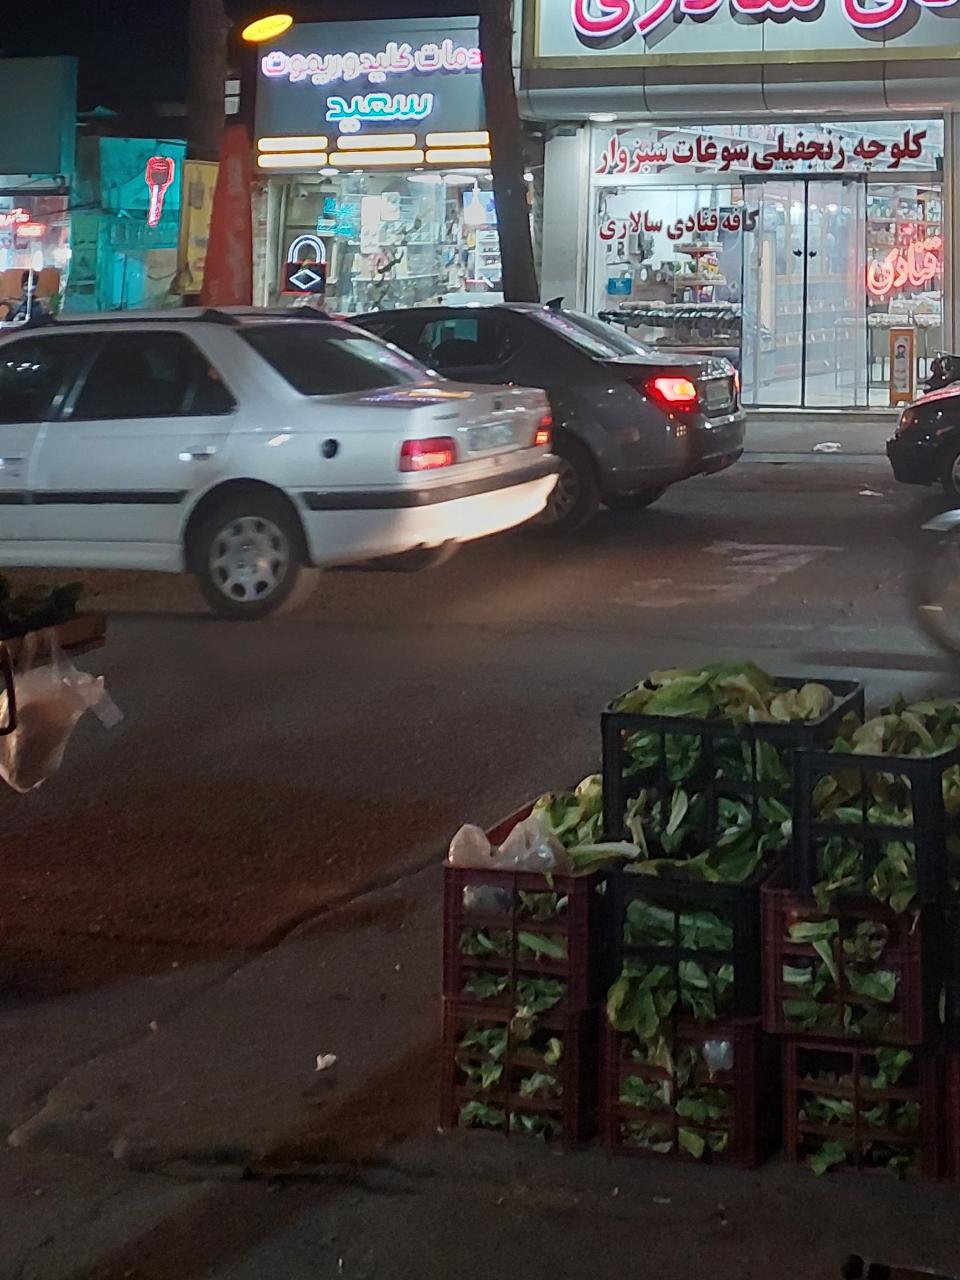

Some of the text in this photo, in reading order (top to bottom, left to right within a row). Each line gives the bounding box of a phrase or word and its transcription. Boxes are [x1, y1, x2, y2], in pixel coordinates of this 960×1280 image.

[415, 39, 483, 72] دمات
[326, 92, 434, 133] سعید
[596, 133, 669, 174] سبزوار
[672, 135, 749, 172] سوغات
[853, 130, 927, 172] کلوچه
[599, 206, 760, 240] کافه قنادی سالاری
